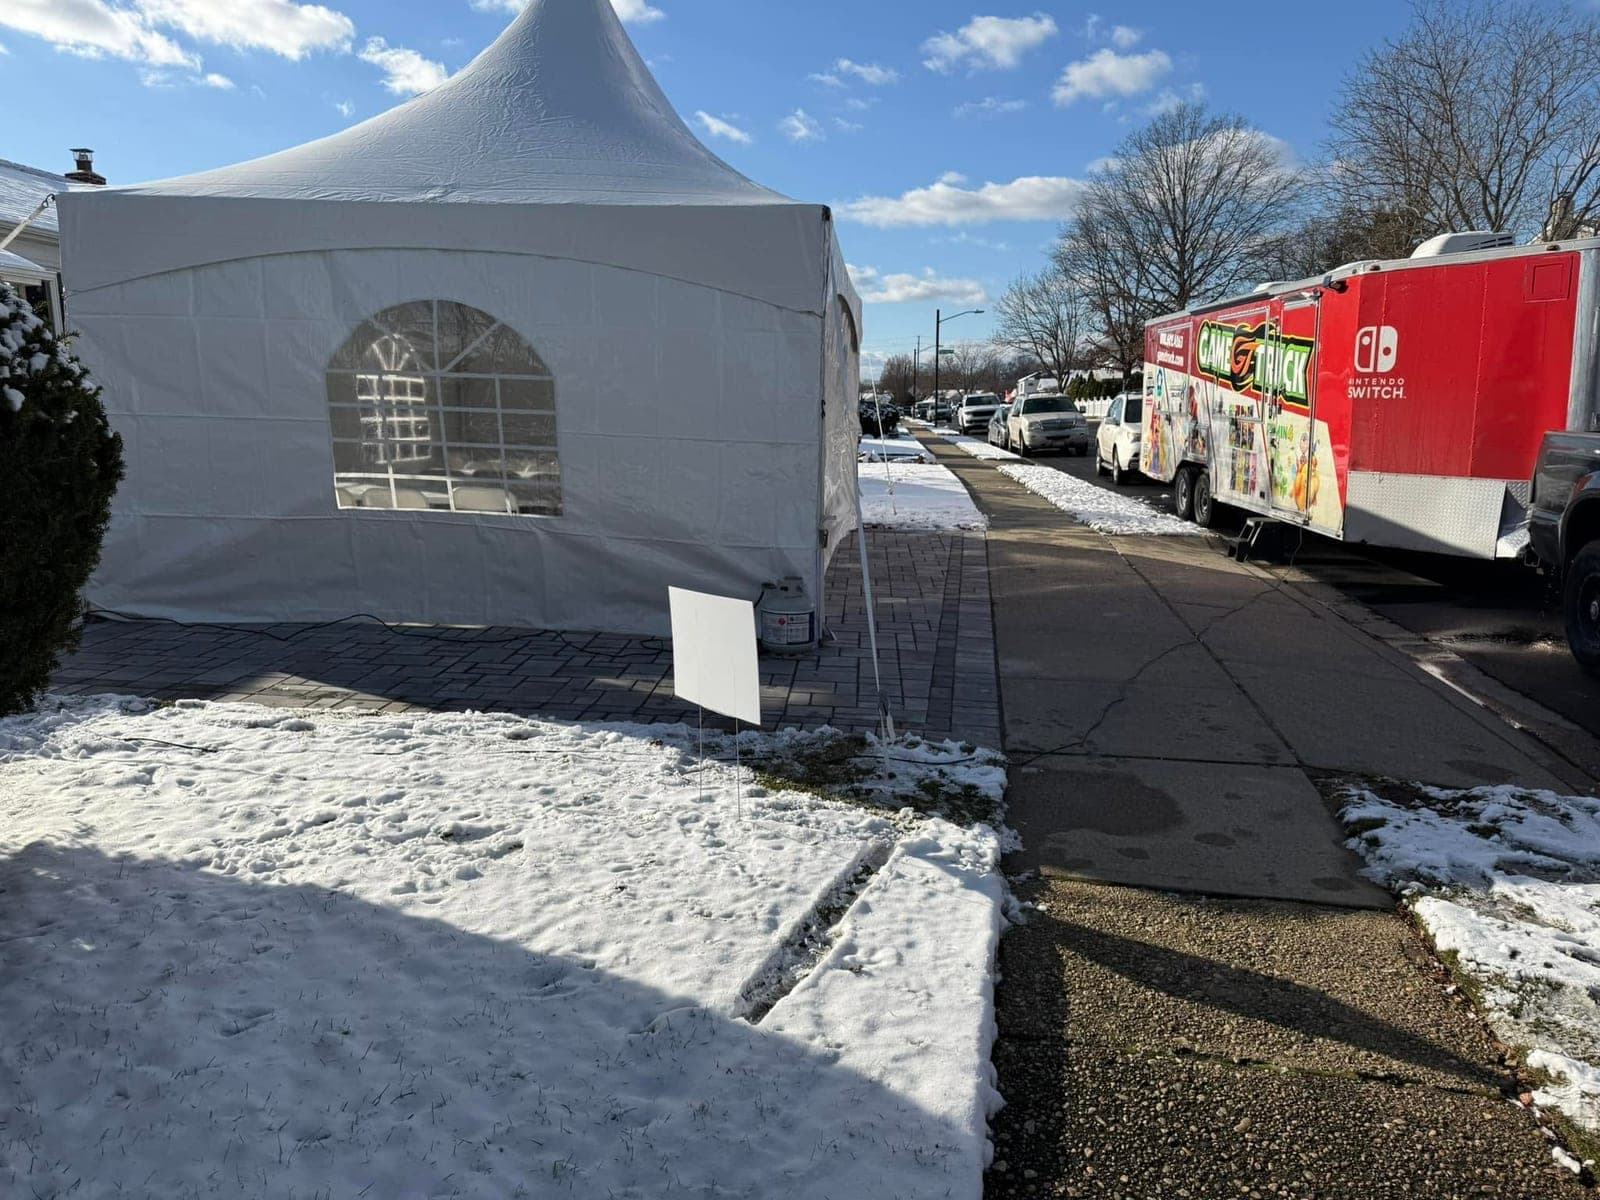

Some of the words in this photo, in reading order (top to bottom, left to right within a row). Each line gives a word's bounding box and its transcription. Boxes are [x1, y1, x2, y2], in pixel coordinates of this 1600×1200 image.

[1199, 329, 1232, 375] GAME
[1254, 342, 1309, 395] TRUCK
[1348, 386, 1404, 399] SWITCH
